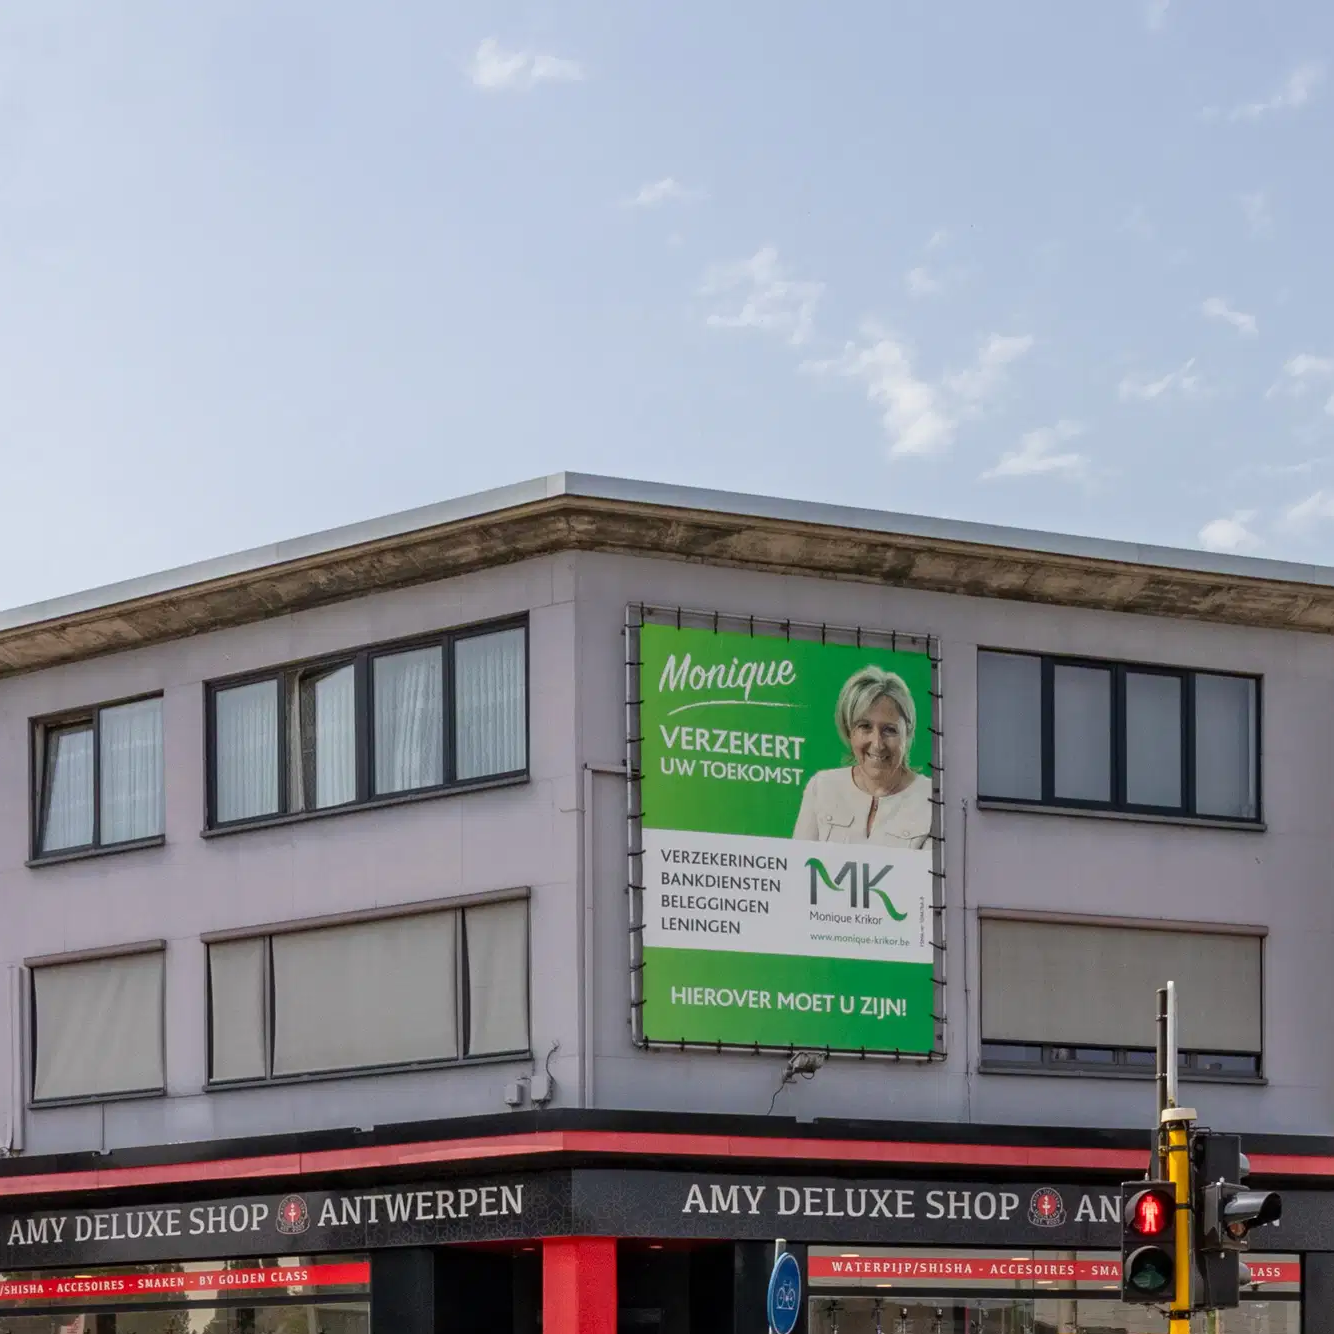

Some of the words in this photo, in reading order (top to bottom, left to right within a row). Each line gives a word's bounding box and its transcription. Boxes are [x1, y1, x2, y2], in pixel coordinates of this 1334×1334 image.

[658, 653, 796, 700] Monique
[659, 724, 805, 760] VERZEKERT
[660, 756, 696, 776] UW
[700, 760, 804, 785] TOEKOMST
[660, 849, 788, 871] VERZEKERINGEN
[661, 872, 781, 892] BANKDIENSTEN
[804, 857, 908, 922] MK
[661, 894, 769, 914] BELEGGINGEN
[661, 917, 741, 934] LENINGEN
[809, 911, 852, 924] Monique
[854, 912, 883, 925] Krikor
[809, 933, 910, 947] www.monique-krikor.be
[670, 986, 771, 1009] HIEROVER
[777, 992, 835, 1012] MOET
[840, 996, 855, 1014] U
[859, 996, 907, 1019] ZIJN!
[682, 1184, 766, 1215] AMY
[777, 1186, 915, 1218] DELUXE
[925, 1190, 1020, 1220] SHOP
[7, 1216, 67, 1246] AMY
[74, 1209, 181, 1242] DELUXE
[188, 1203, 269, 1235] SHOP
[317, 1184, 524, 1227] ANTWERPEN
[831, 1261, 973, 1274] WATERPIJP/SHISHA
[990, 1264, 1075, 1275] ACCESOIRES
[1091, 1265, 1119, 1276] SMA
[1250, 1267, 1281, 1277] LASS
[57, 1279, 125, 1293] ACCESOIRES
[137, 1277, 184, 1289] SMAKEN
[199, 1275, 213, 1286] BY
[219, 1272, 266, 1285] GOLDEN
[270, 1271, 308, 1282] CLASS
